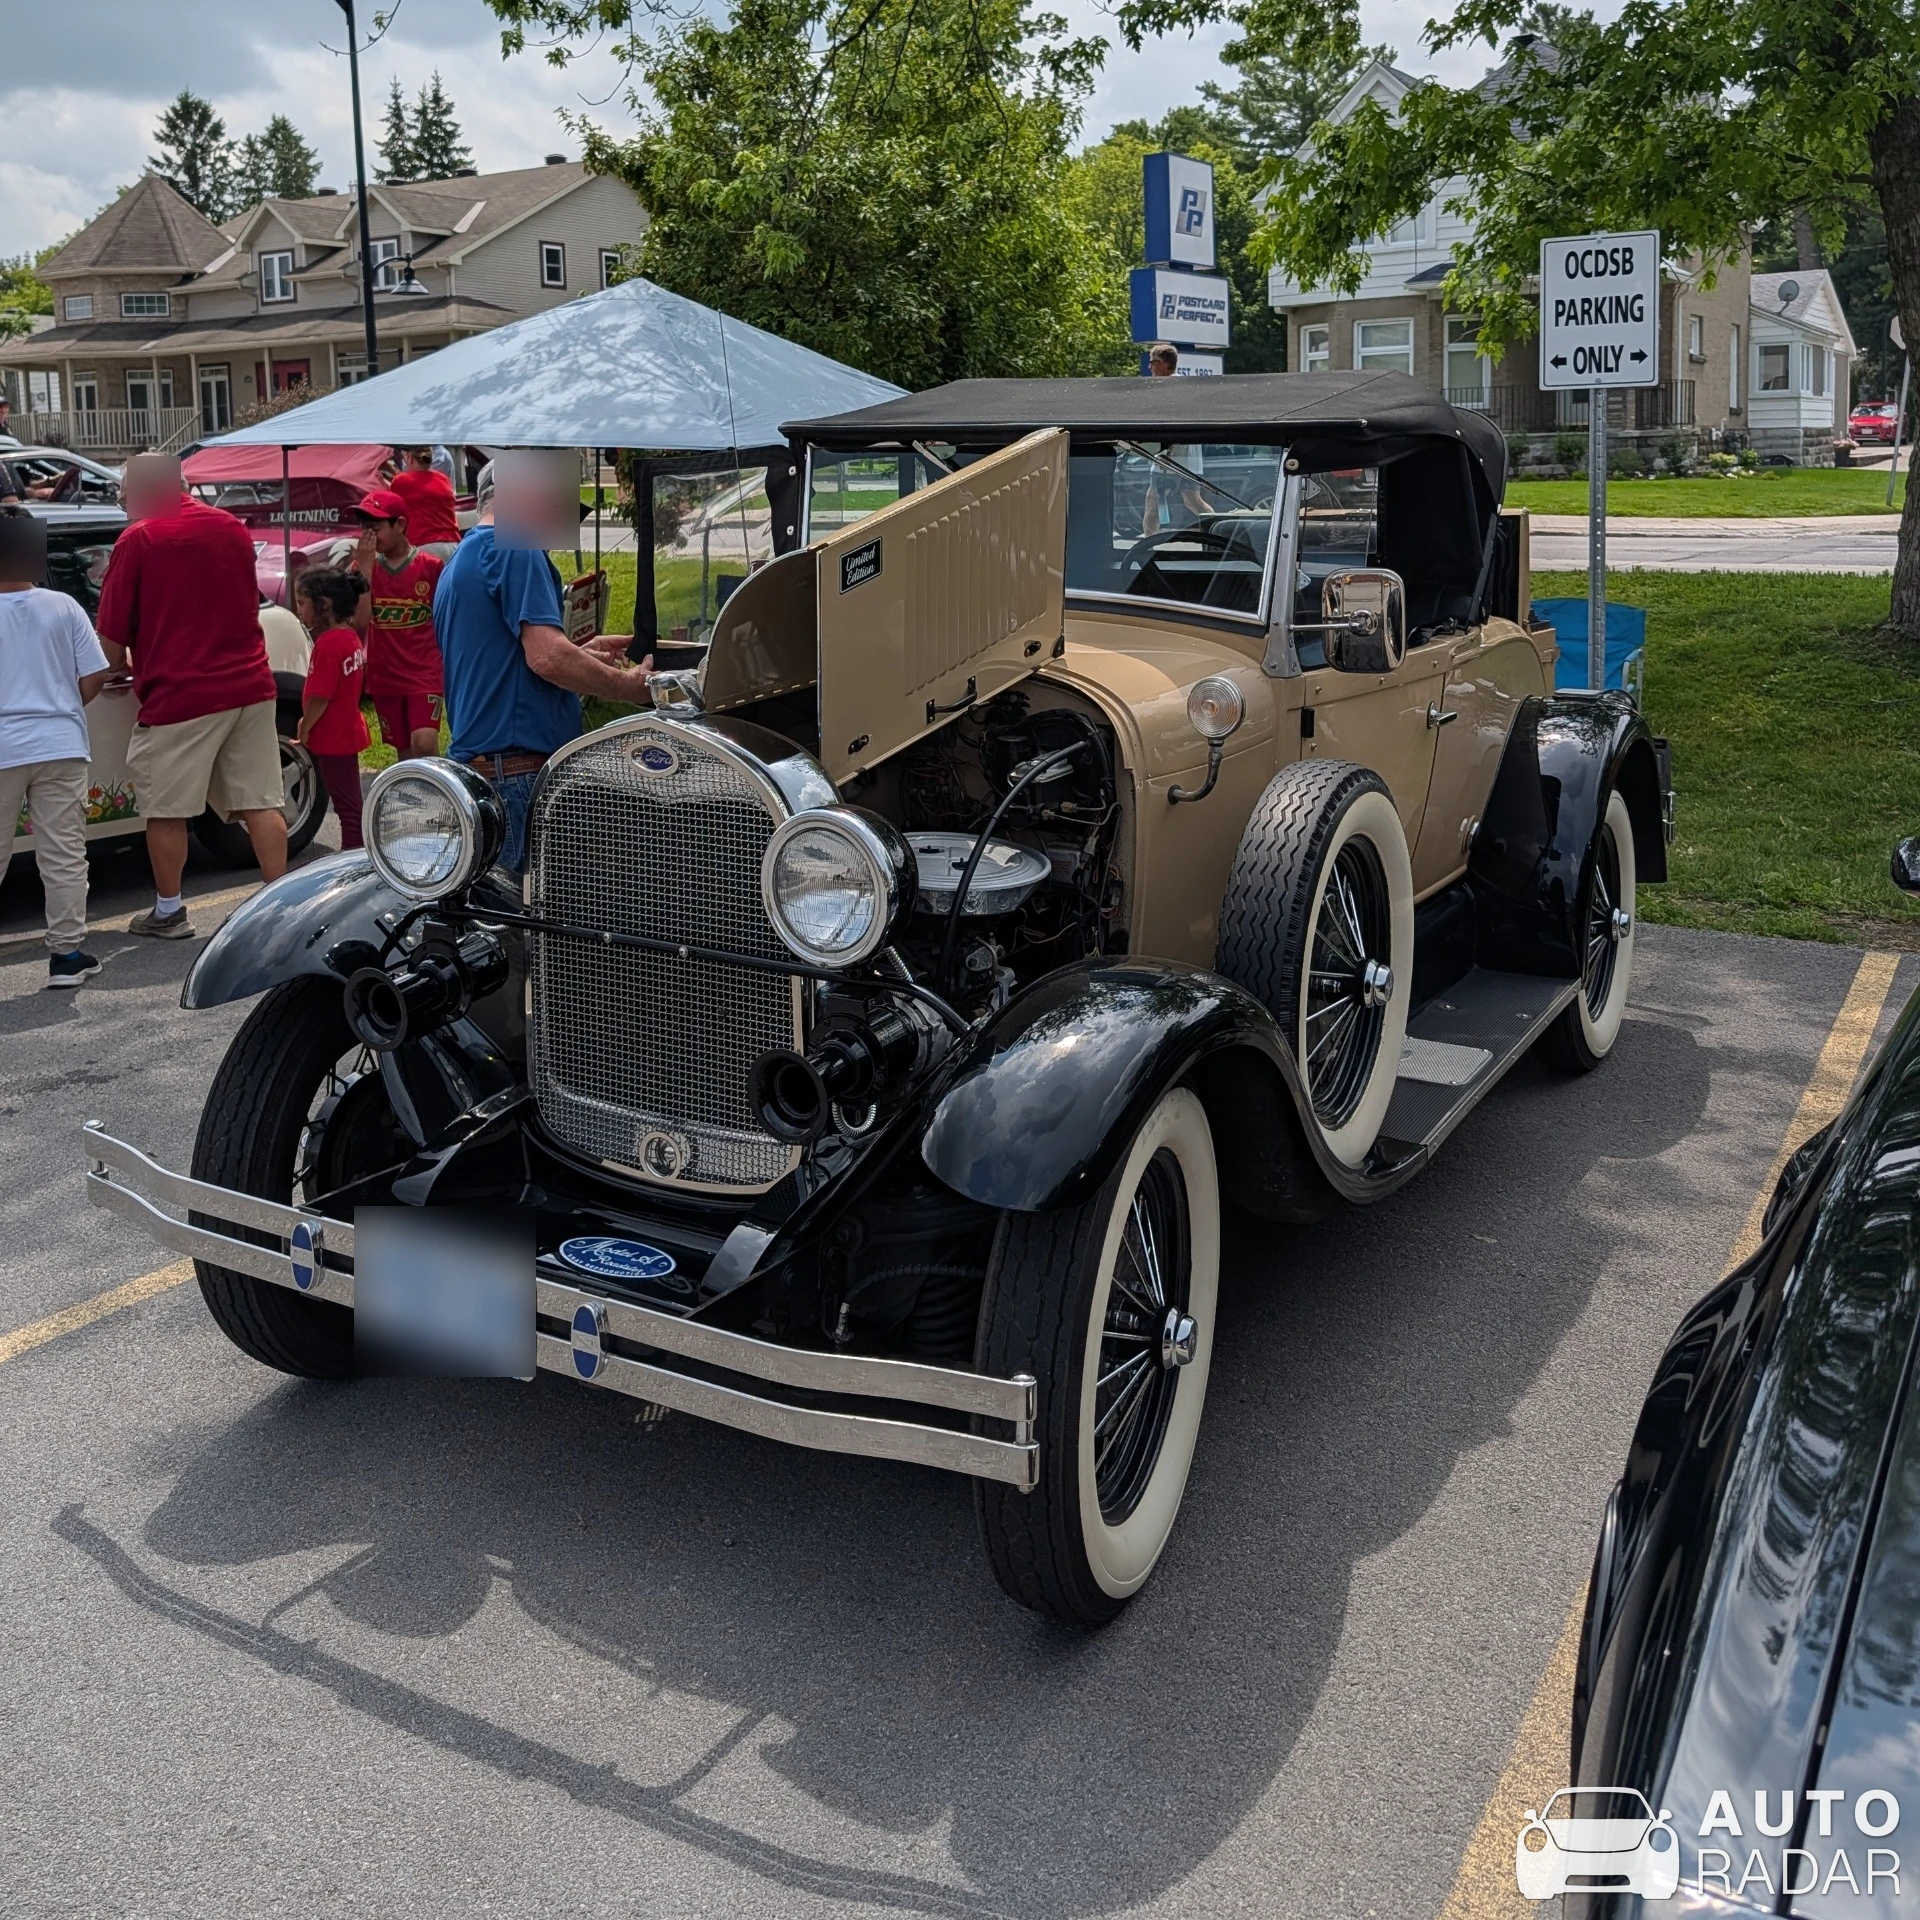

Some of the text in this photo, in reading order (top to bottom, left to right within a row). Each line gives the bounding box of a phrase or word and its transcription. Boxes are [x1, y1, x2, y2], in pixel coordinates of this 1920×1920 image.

[1565, 247, 1634, 279] OCDSB
[1176, 309, 1217, 324] PERFECT
[1178, 296, 1226, 311] POSTCARD
[1554, 294, 1644, 327] PARKING
[1573, 345, 1625, 374] ONLY
[846, 545, 876, 572] Limited
[847, 564, 876, 585] Edition
[427, 694, 444, 721] 7
[645, 749, 673, 765] Ford
[569, 1239, 665, 1265] Model A
[585, 1262, 647, 1276] REPRODUCTION
